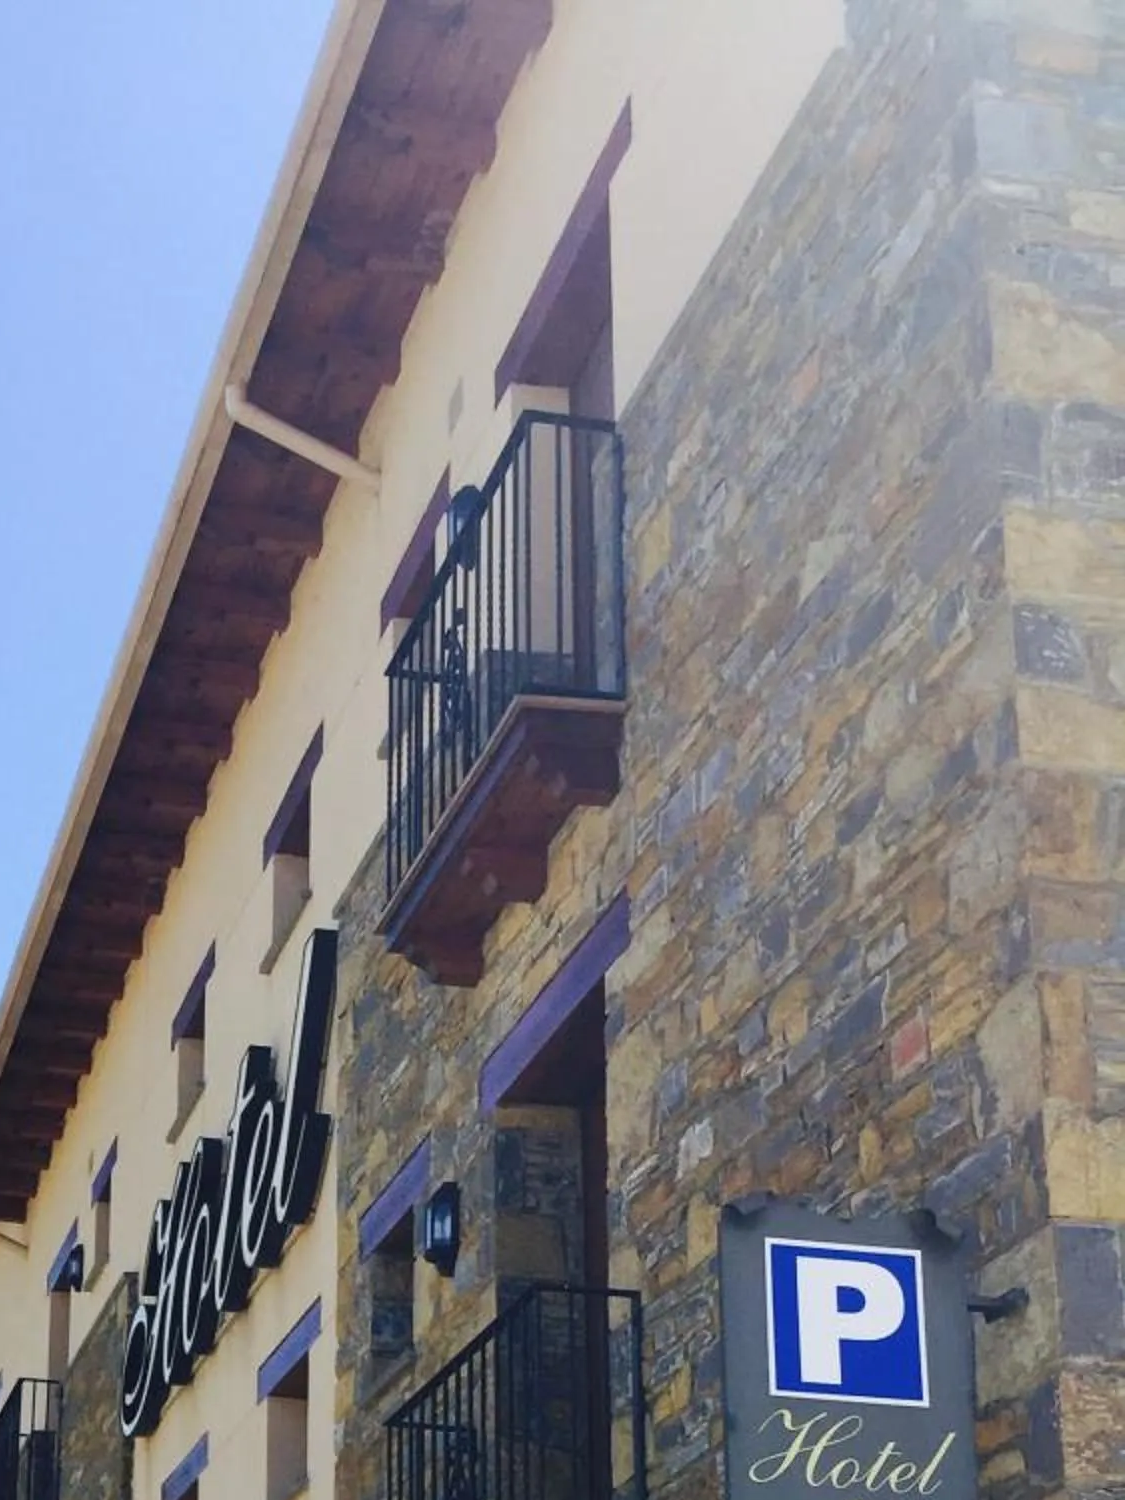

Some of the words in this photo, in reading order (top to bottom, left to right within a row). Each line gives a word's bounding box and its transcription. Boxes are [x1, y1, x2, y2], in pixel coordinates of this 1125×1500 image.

[121, 928, 336, 1435] Hotel
[796, 1256, 905, 1385] P
[748, 1408, 956, 1495] Hotel
